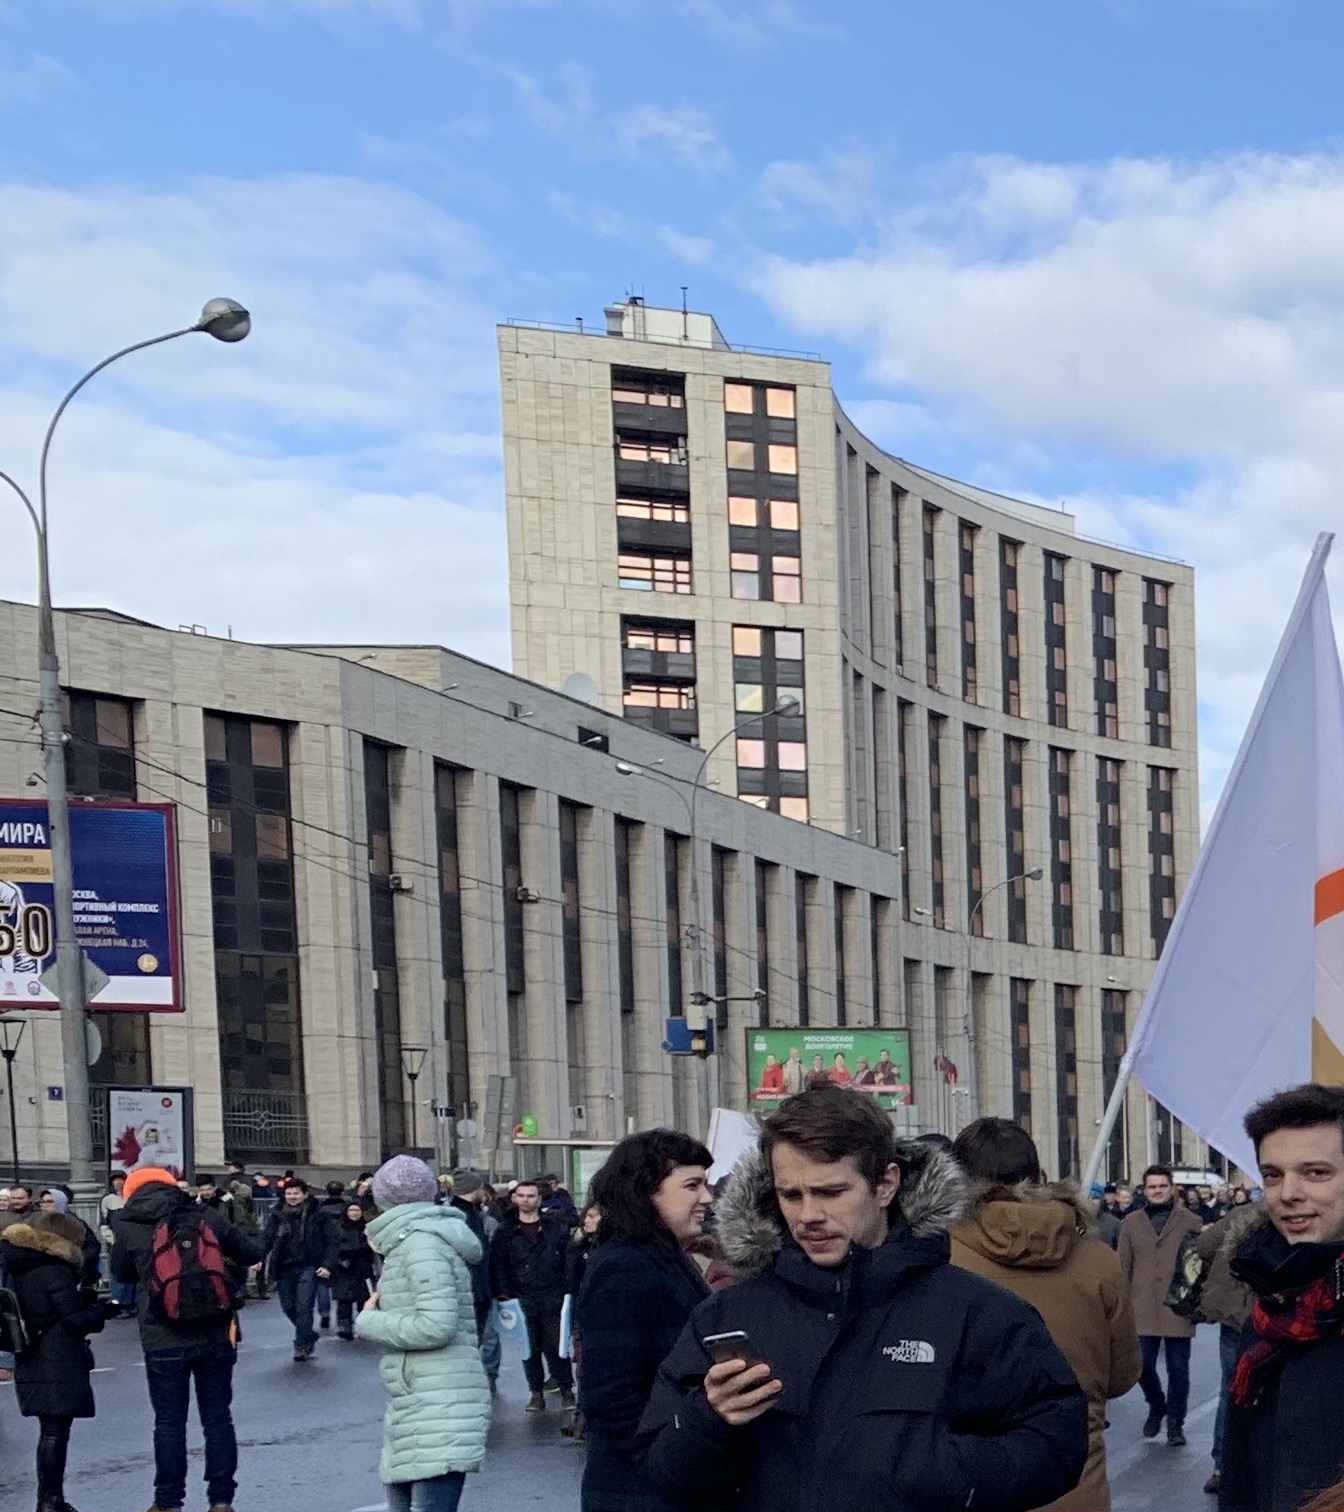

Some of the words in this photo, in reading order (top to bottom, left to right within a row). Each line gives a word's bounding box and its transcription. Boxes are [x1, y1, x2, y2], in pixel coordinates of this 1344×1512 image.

[72, 901, 117, 912] ПОРТИВНЫЙ
[803, 1035, 855, 1043] МОСКОВСКОЕ
[805, 1043, 853, 1051] ДОЛГОЛЕТИЕ
[899, 1340, 920, 1349] THE
[883, 1346, 919, 1356] NORTH
[891, 1354, 917, 1363] FACE
